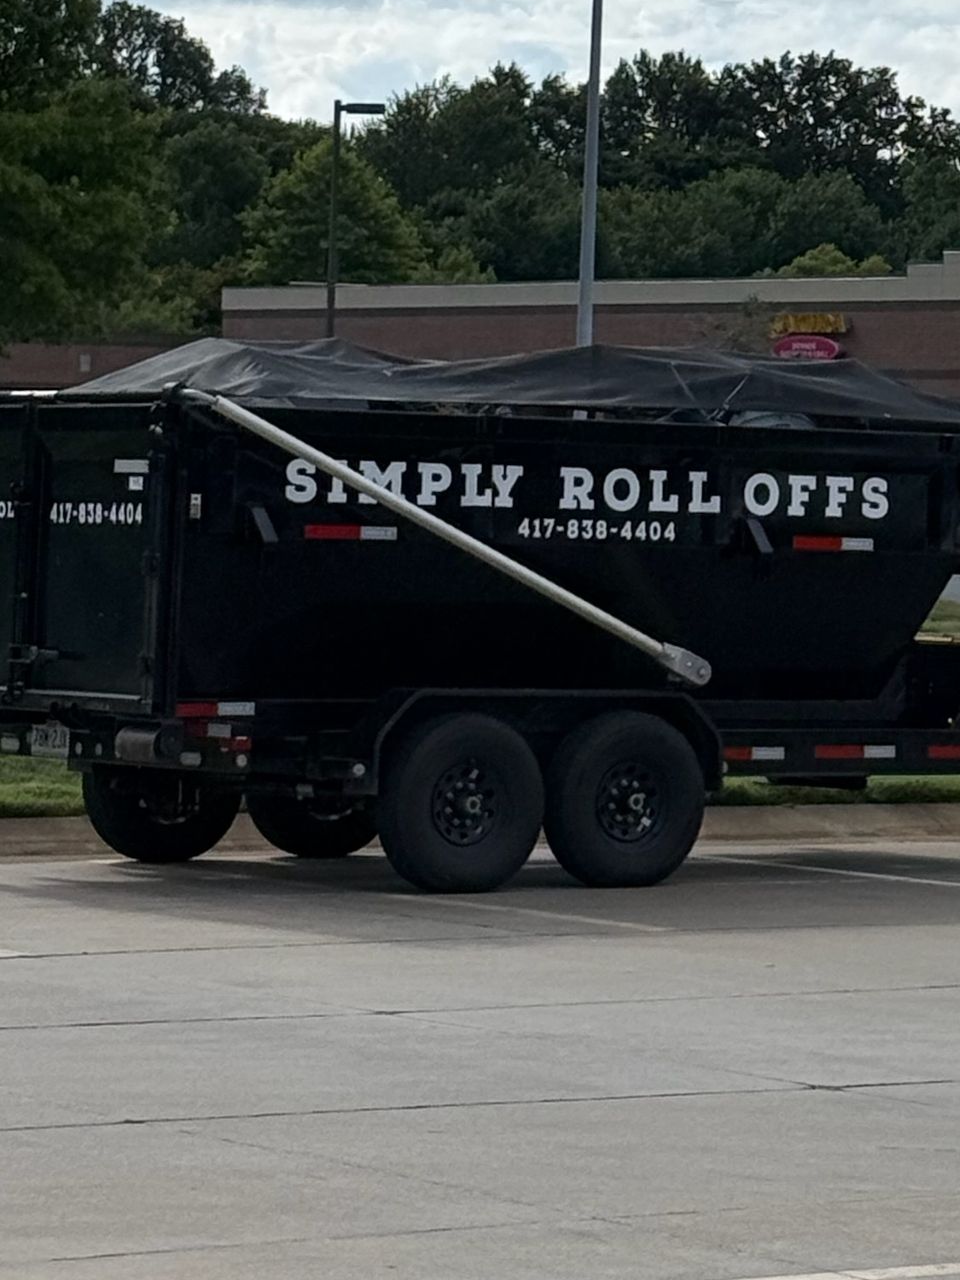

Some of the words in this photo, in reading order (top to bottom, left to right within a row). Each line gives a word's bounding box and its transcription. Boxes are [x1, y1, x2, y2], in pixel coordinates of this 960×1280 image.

[285, 458, 524, 508] SIMPLY
[559, 466, 721, 514] ROLL
[744, 472, 889, 519] OFFS
[50, 503, 143, 524] 417-838-4404
[518, 518, 676, 542] 417-838-4404
